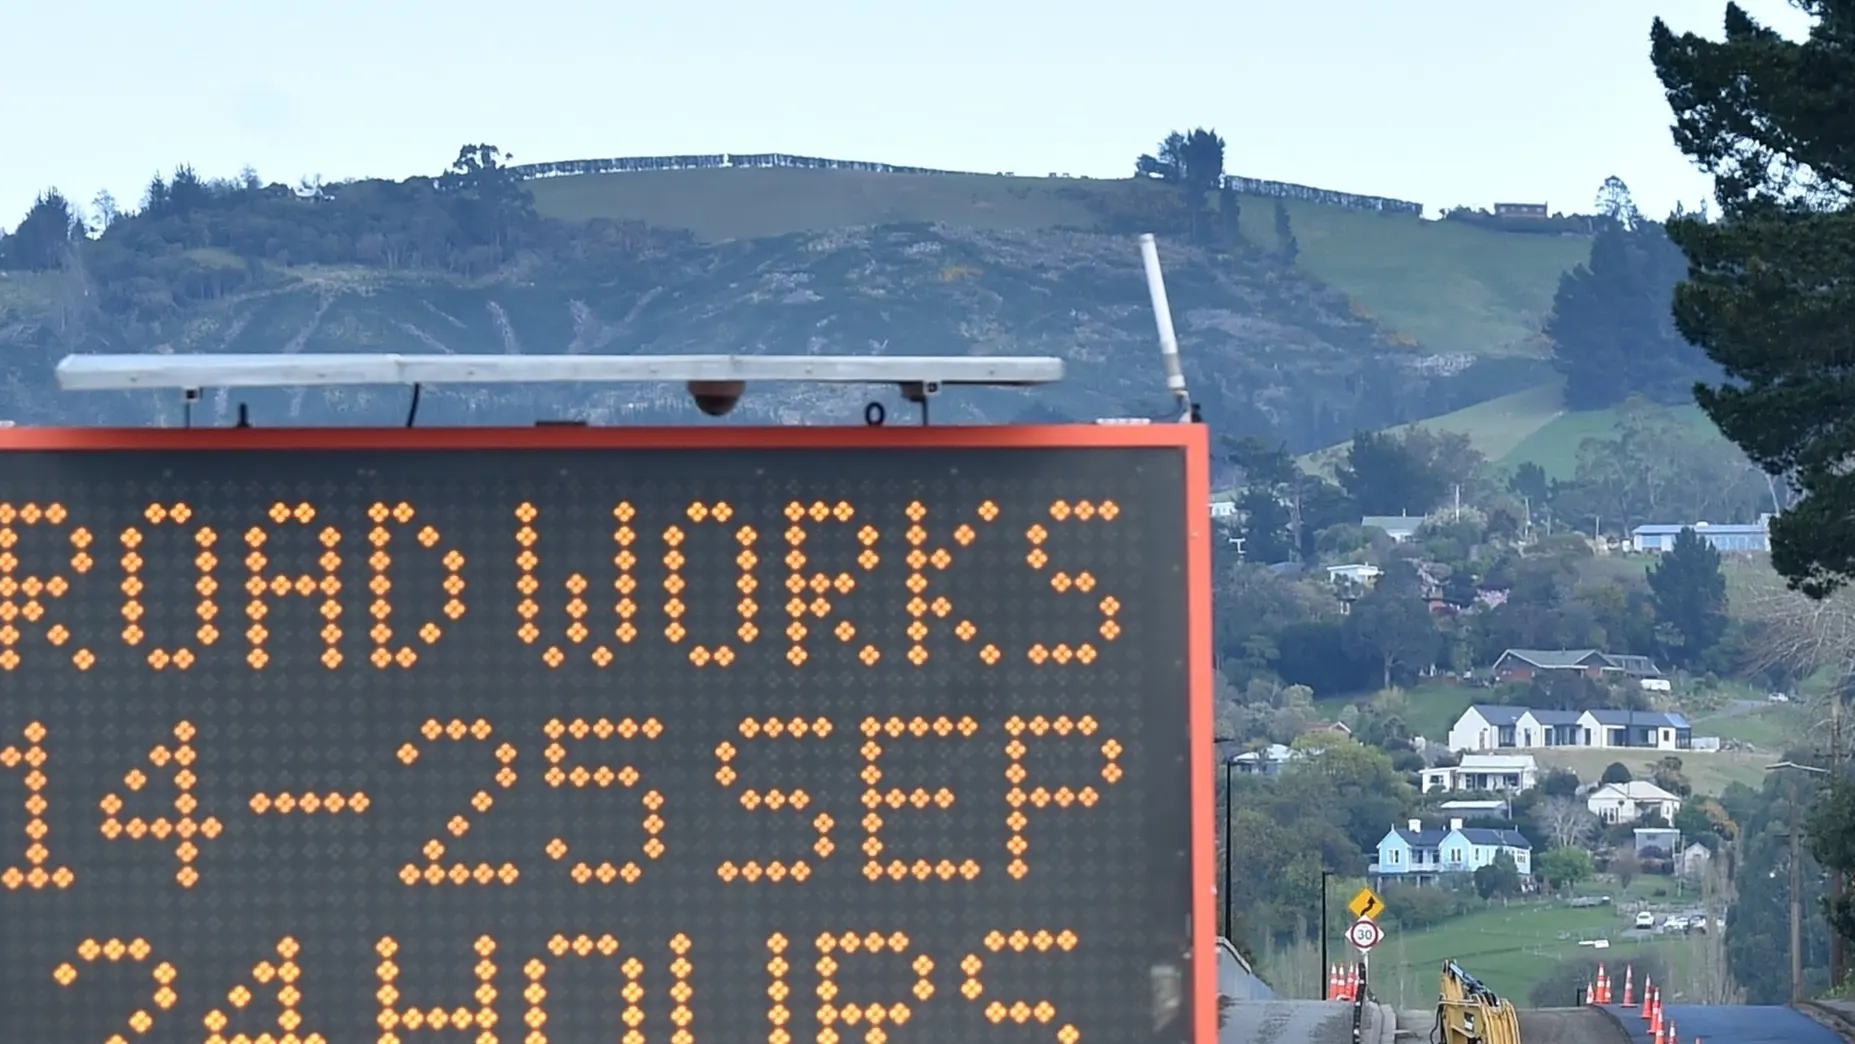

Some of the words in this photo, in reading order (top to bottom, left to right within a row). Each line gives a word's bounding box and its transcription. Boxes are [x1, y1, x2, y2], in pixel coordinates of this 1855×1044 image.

[0, 501, 466, 671] ROAD
[515, 499, 1121, 670] WORKS
[714, 714, 1123, 884] SEP
[1357, 929, 1372, 941] 30
